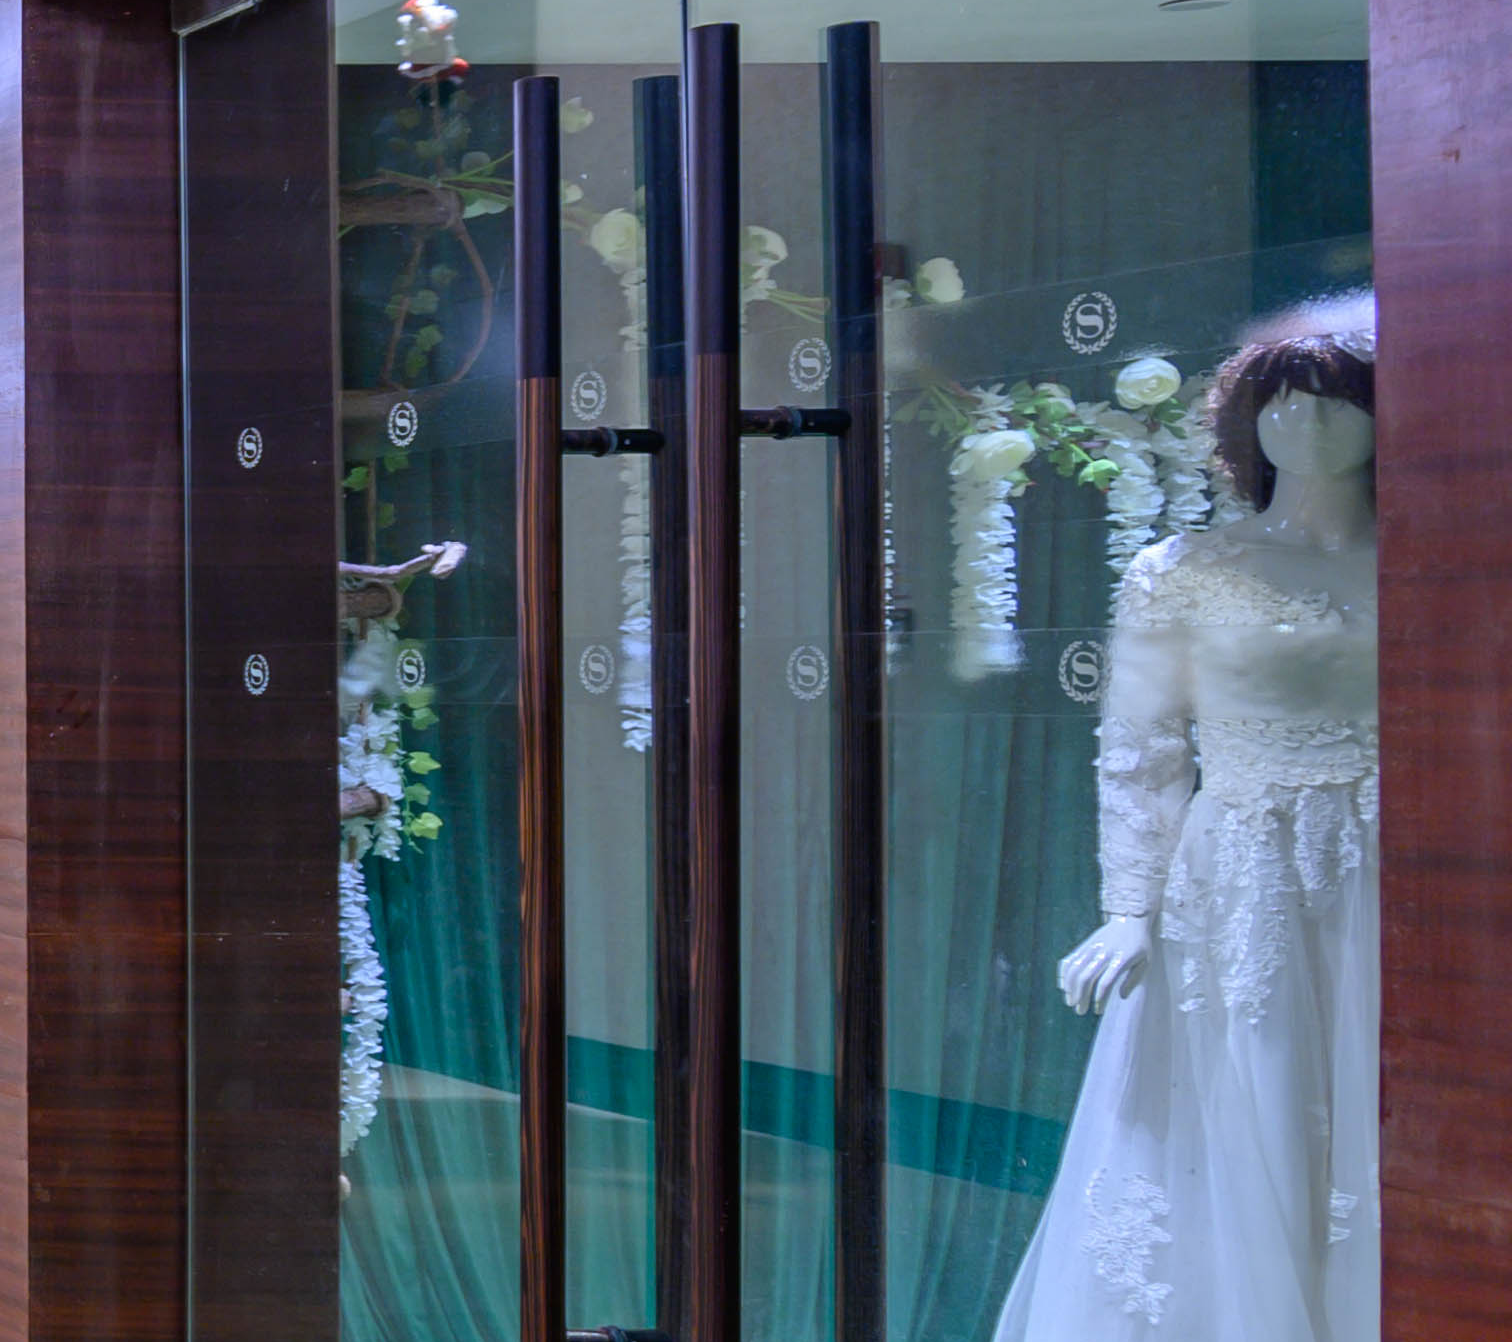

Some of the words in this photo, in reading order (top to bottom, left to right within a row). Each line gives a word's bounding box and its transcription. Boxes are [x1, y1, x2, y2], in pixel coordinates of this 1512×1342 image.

[1076, 303, 1104, 339] S
[798, 347, 821, 379] S
[579, 380, 598, 409] S
[395, 410, 411, 436] S
[243, 435, 257, 459] S
[250, 661, 264, 685] S
[401, 657, 418, 683] S
[587, 653, 606, 682] S
[796, 655, 819, 687] S
[1072, 651, 1099, 687] S
